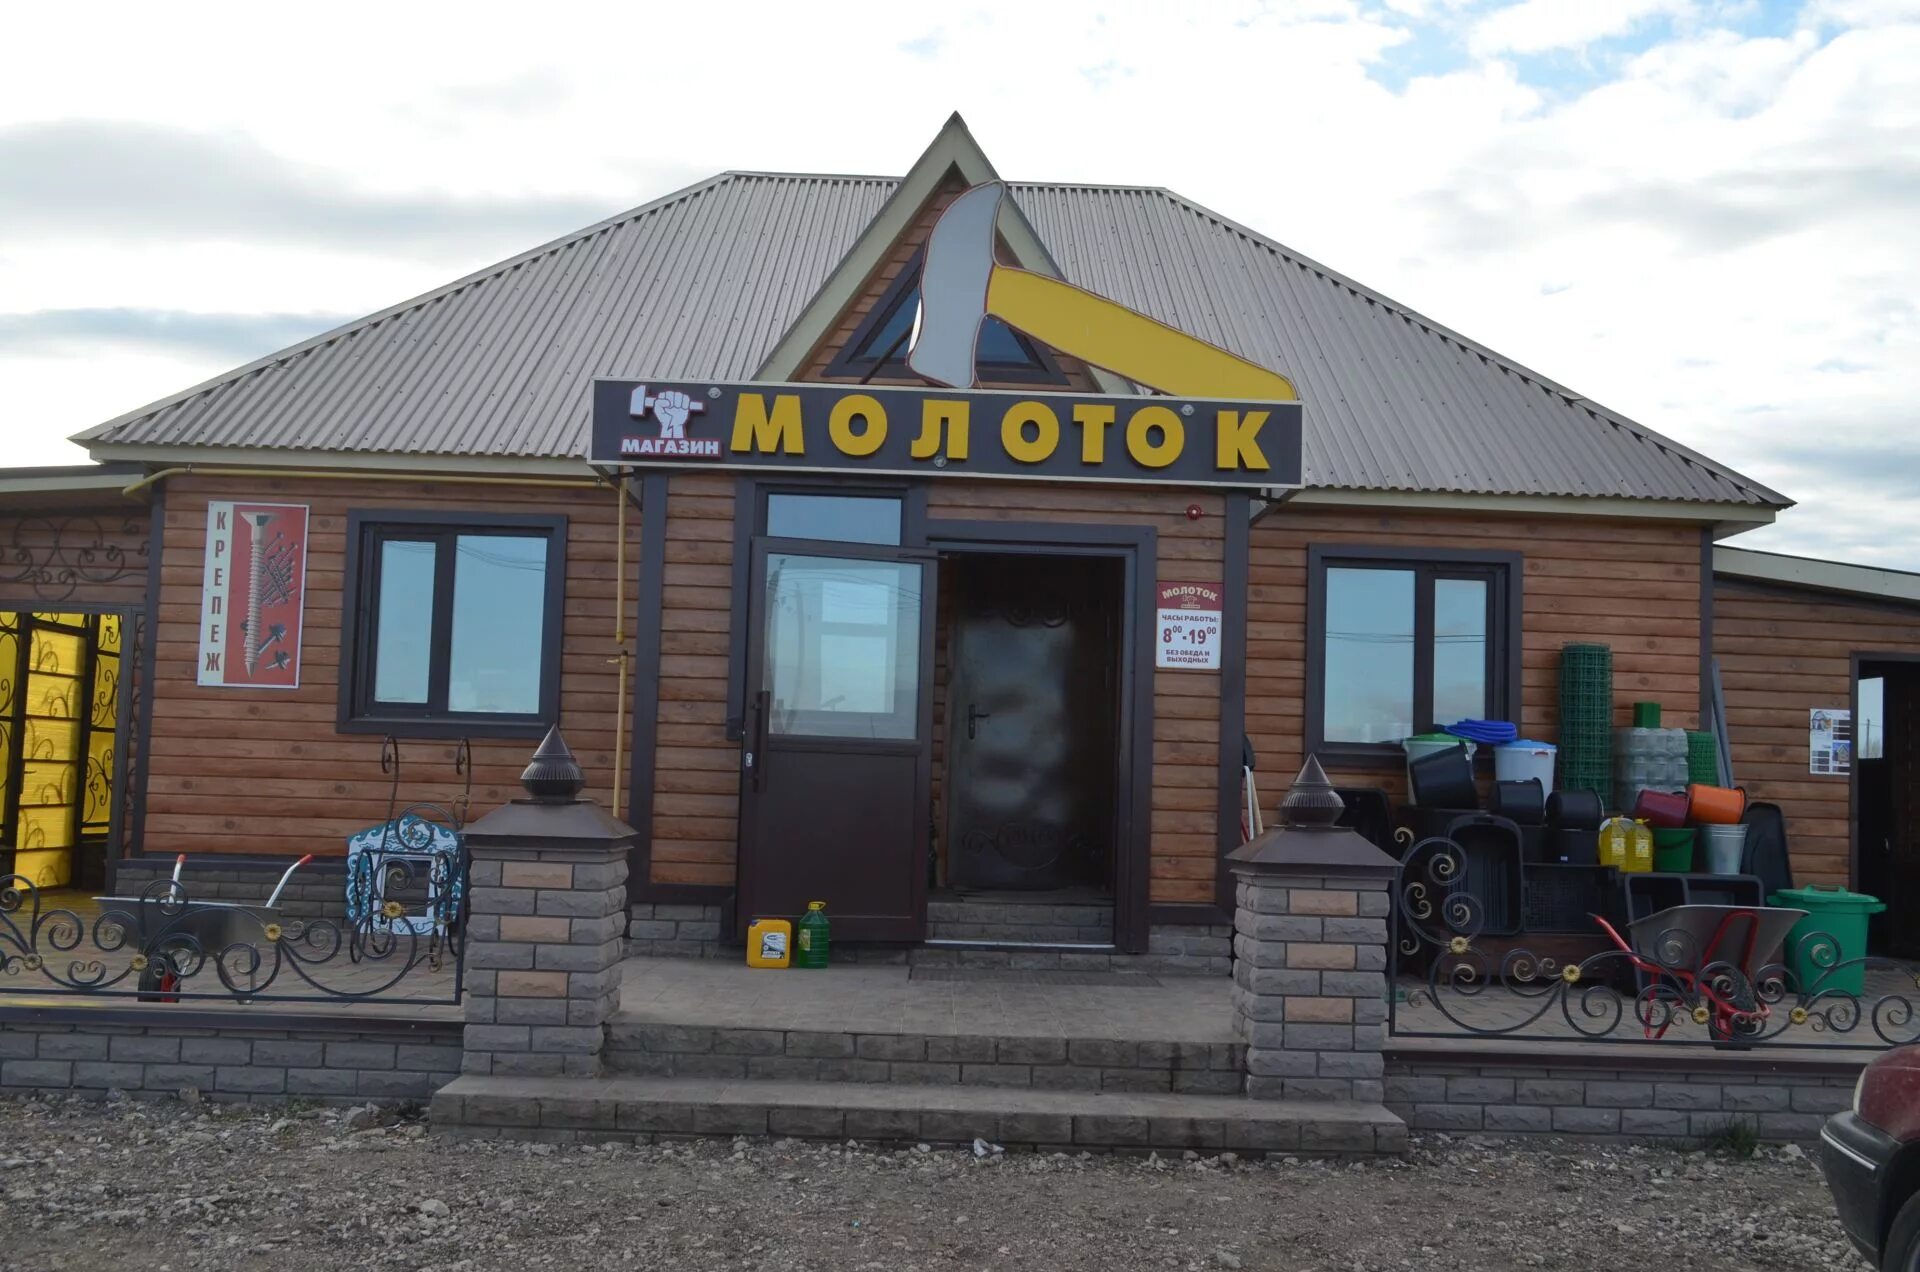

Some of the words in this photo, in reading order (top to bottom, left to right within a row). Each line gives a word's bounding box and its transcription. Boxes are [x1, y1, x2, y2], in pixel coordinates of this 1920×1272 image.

[621, 439, 719, 455] МАГАЗИН
[729, 393, 1271, 471] МОЛОТОК
[205, 511, 227, 672] КРЕПЕЖ
[1162, 586, 1218, 601] МОЛОТОК
